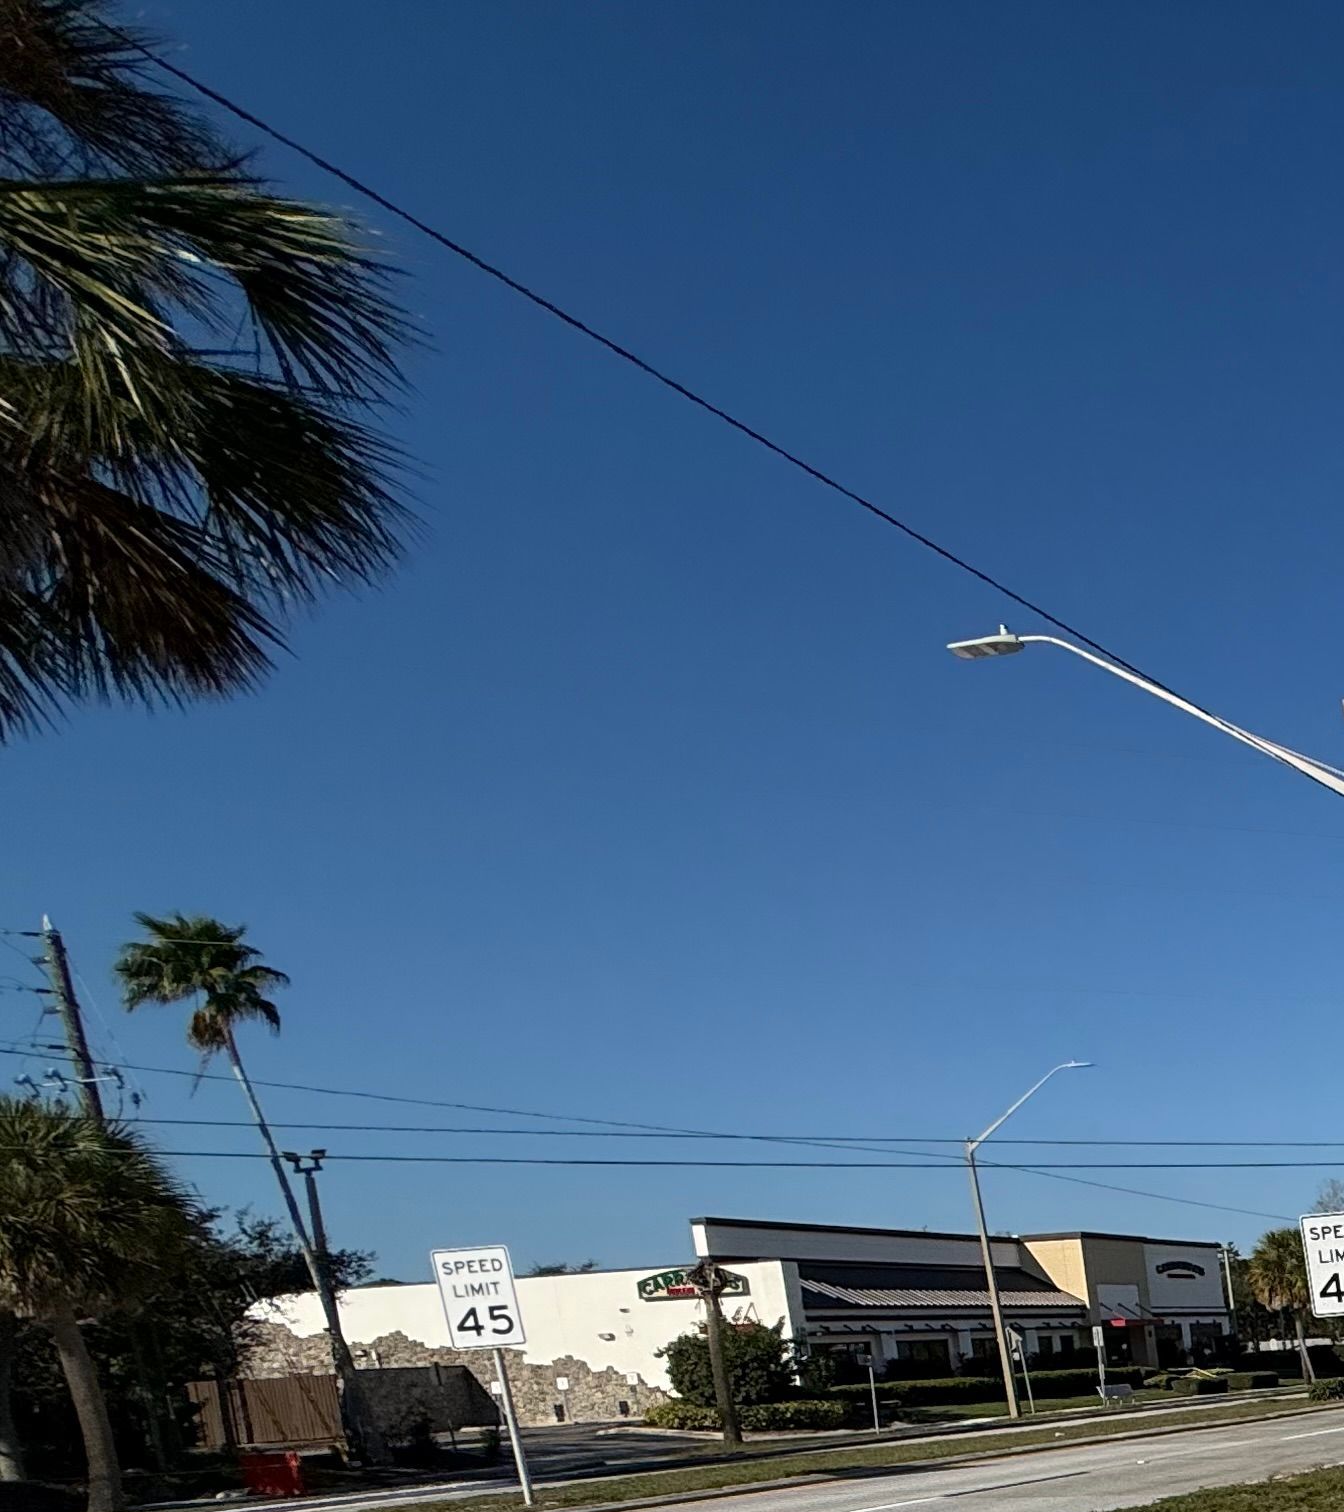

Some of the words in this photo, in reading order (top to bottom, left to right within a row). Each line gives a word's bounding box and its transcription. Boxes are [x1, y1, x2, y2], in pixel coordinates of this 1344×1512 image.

[441, 1258, 503, 1275] SPEED
[452, 1281, 500, 1298] LIMIT
[457, 1304, 514, 1337] 45
